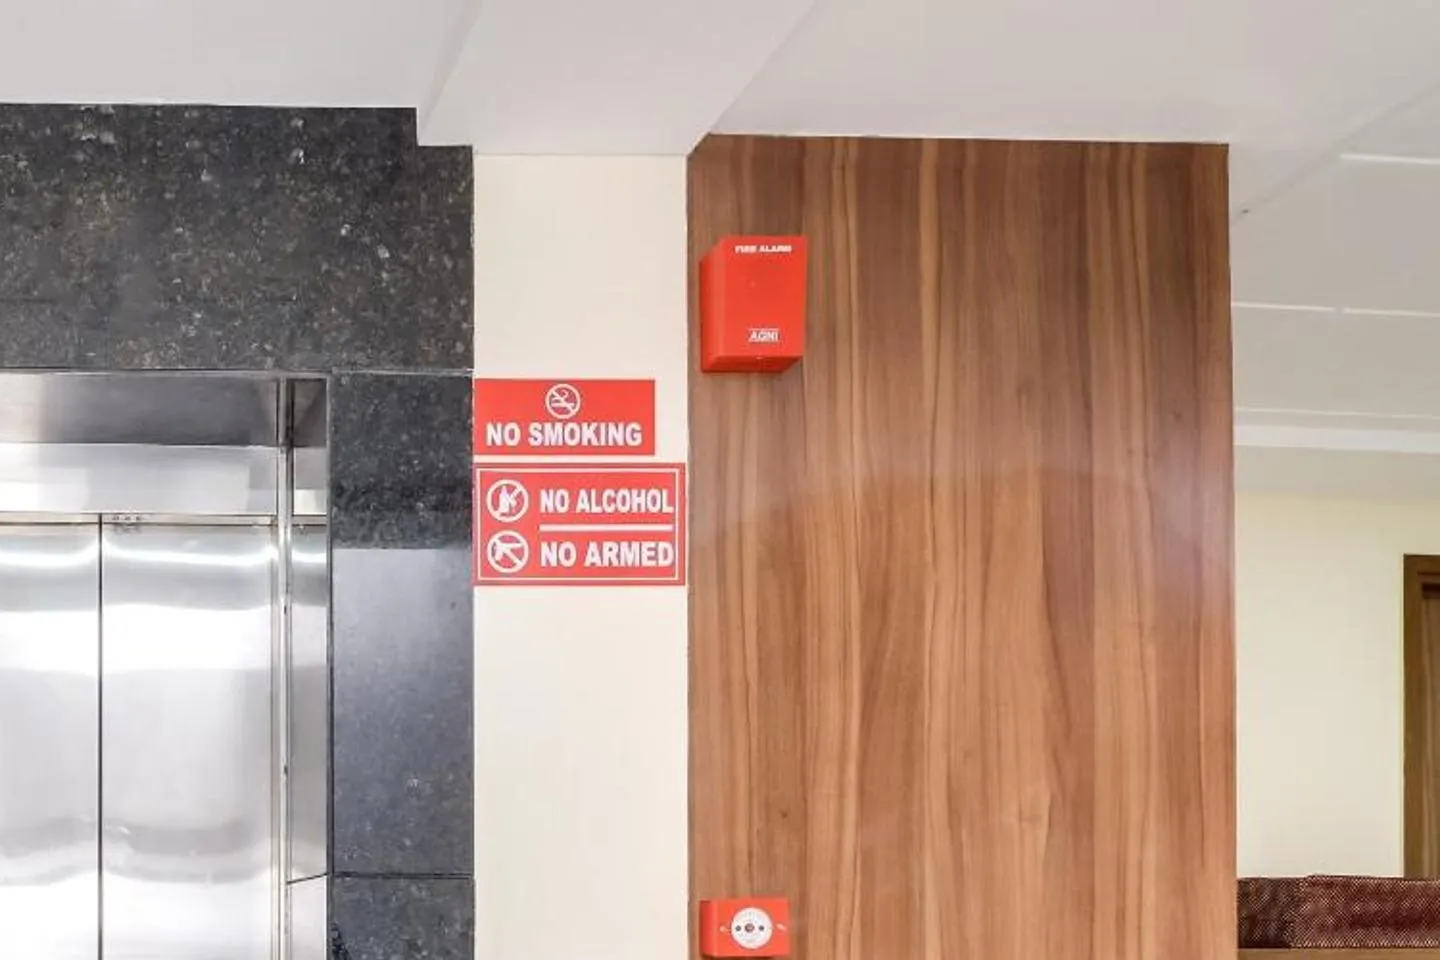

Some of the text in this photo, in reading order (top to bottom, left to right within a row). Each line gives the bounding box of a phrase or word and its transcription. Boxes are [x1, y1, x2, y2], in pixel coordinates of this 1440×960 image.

[486, 422, 643, 447] NO SMOKING
[539, 488, 674, 513] NO ALCOHOL
[540, 541, 674, 567] NO ARMED
